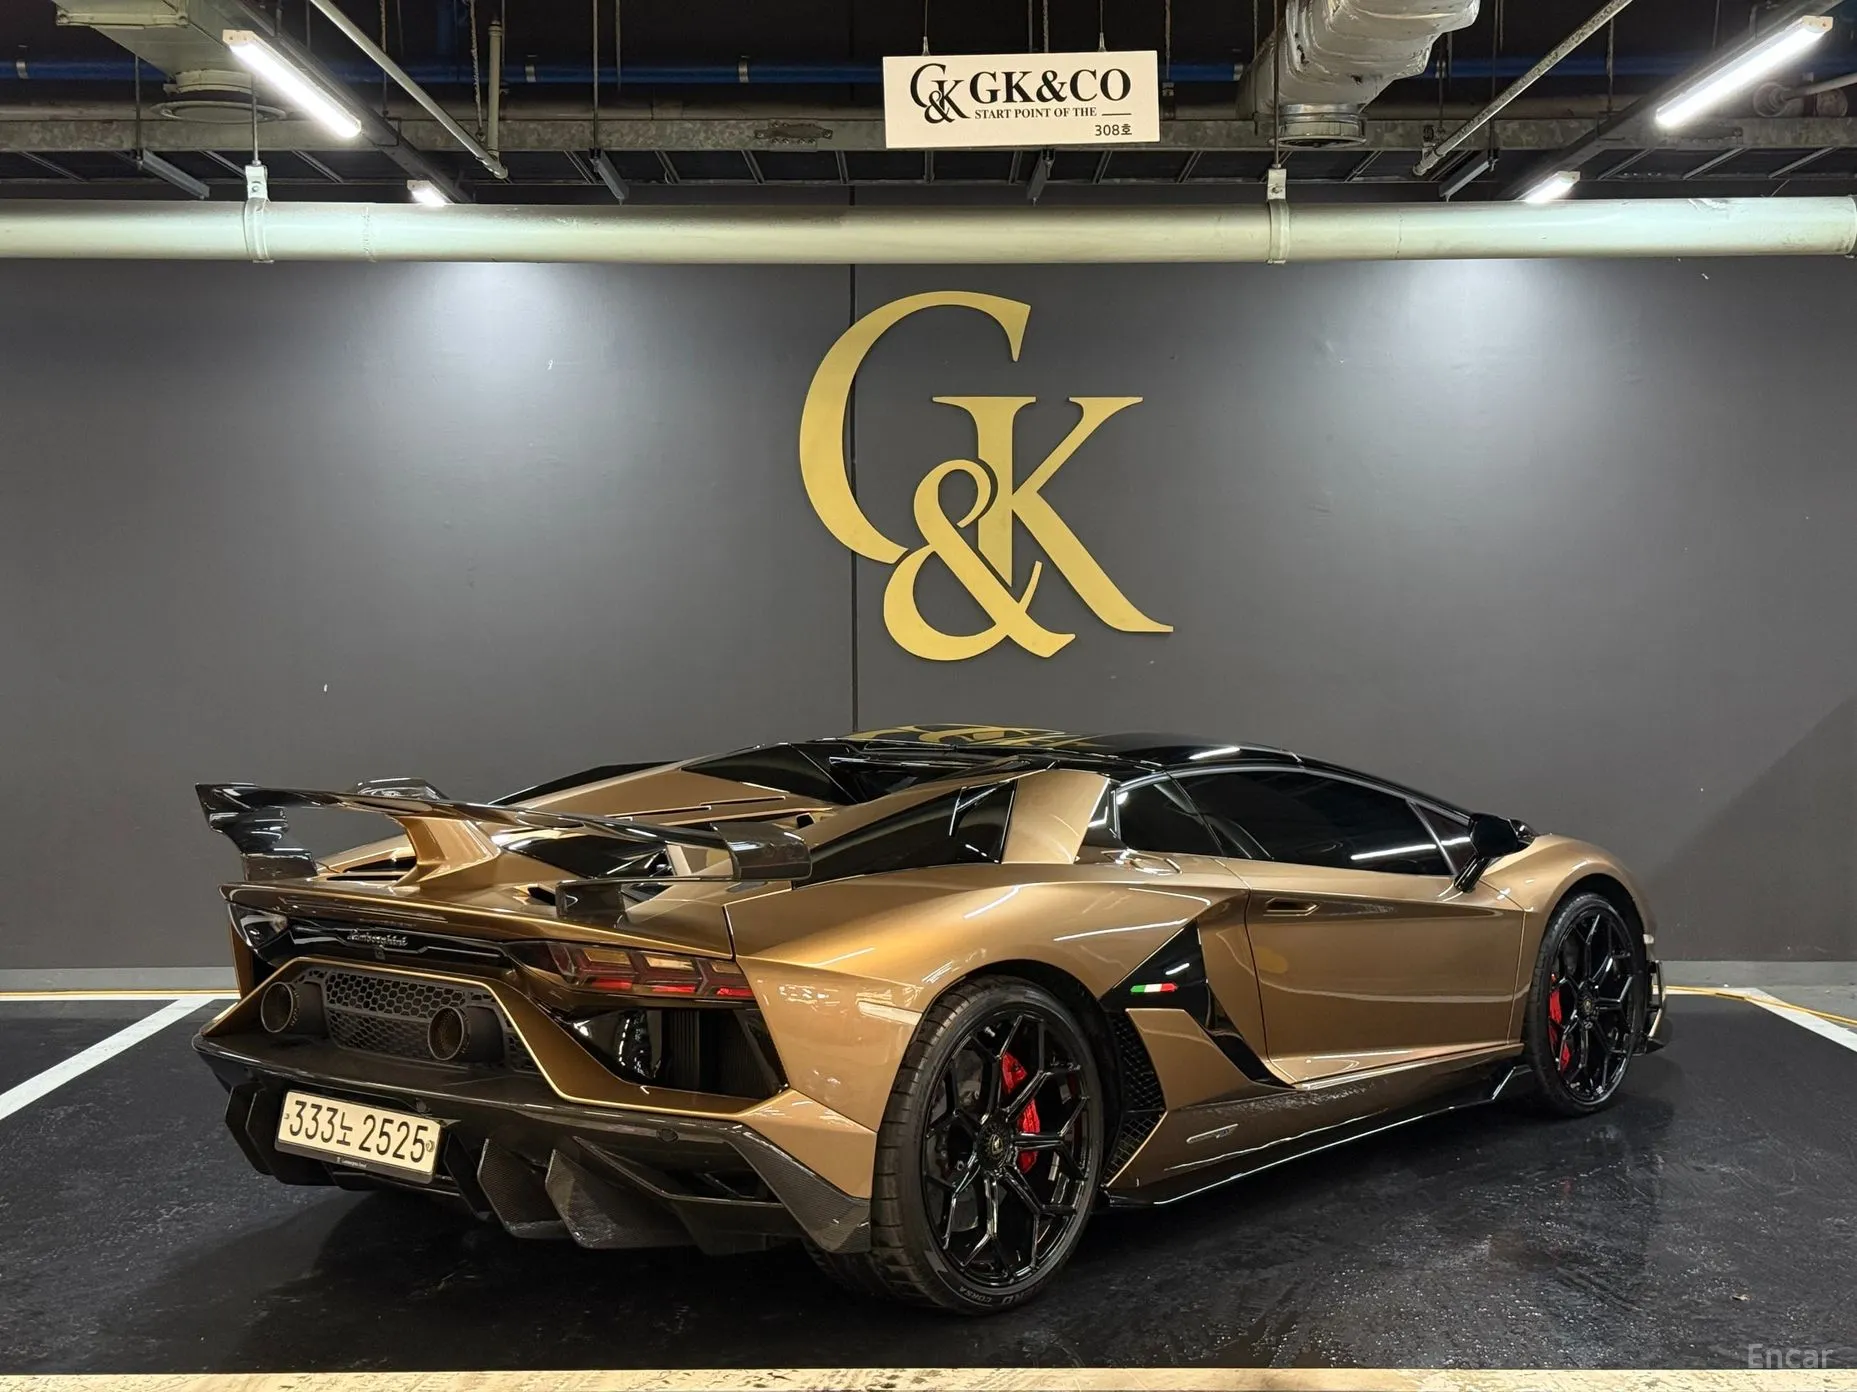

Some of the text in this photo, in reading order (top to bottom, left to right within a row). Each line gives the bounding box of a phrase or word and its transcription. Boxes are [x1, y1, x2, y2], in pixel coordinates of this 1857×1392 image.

[969, 68, 1131, 104] GK&CO
[974, 107, 1097, 119] START POINT OF THE
[1094, 124, 1132, 136] 308호
[289, 1100, 428, 1163] 333노 2525
